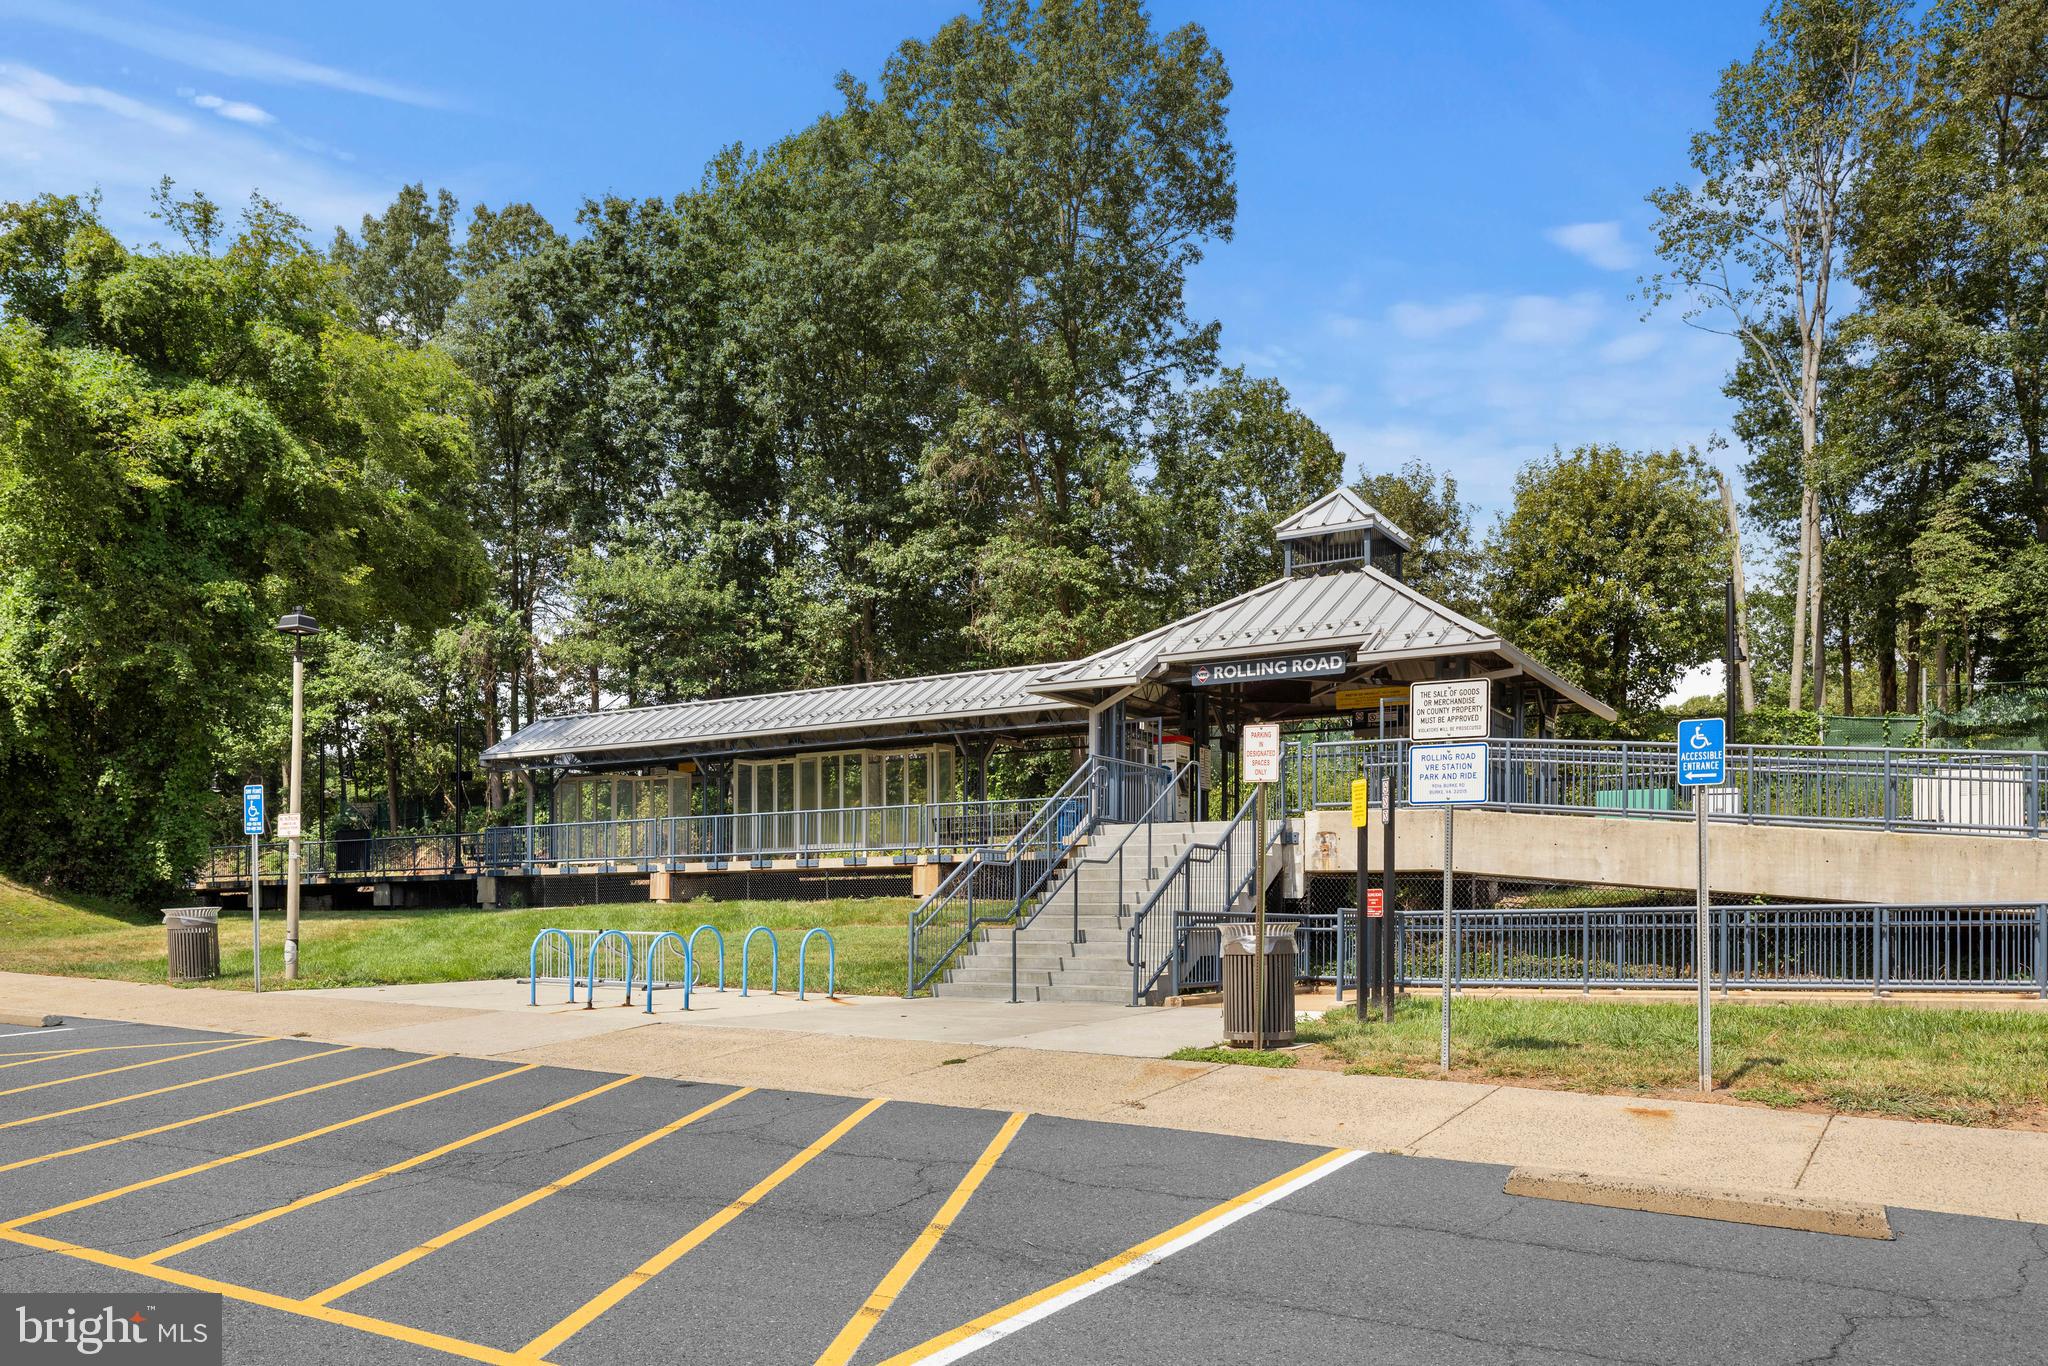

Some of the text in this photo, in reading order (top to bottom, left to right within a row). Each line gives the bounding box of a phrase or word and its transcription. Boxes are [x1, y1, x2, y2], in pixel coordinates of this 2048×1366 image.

[1213, 661, 1287, 680] ROLLING
[1292, 655, 1343, 673] ROAD
[1433, 690, 1447, 698] SALE
[1449, 689, 1457, 697] OF
[1459, 688, 1480, 696] GOODS
[1423, 696, 1476, 707] OR MERCHANDISE
[1416, 705, 1483, 716] ON COUNTY PROPERTY
[1420, 716, 1436, 724] MUST
[1447, 714, 1479, 722] APPROVED
[1421, 752, 1476, 761] ROLLING ROAD
[1680, 750, 1722, 761] ACCESSIBLE
[1425, 762, 1473, 771] VRE STATION
[1682, 761, 1719, 771] ENTRANCE
[1441, 772, 1458, 780] AND
[1460, 771, 1477, 779] RIDE
